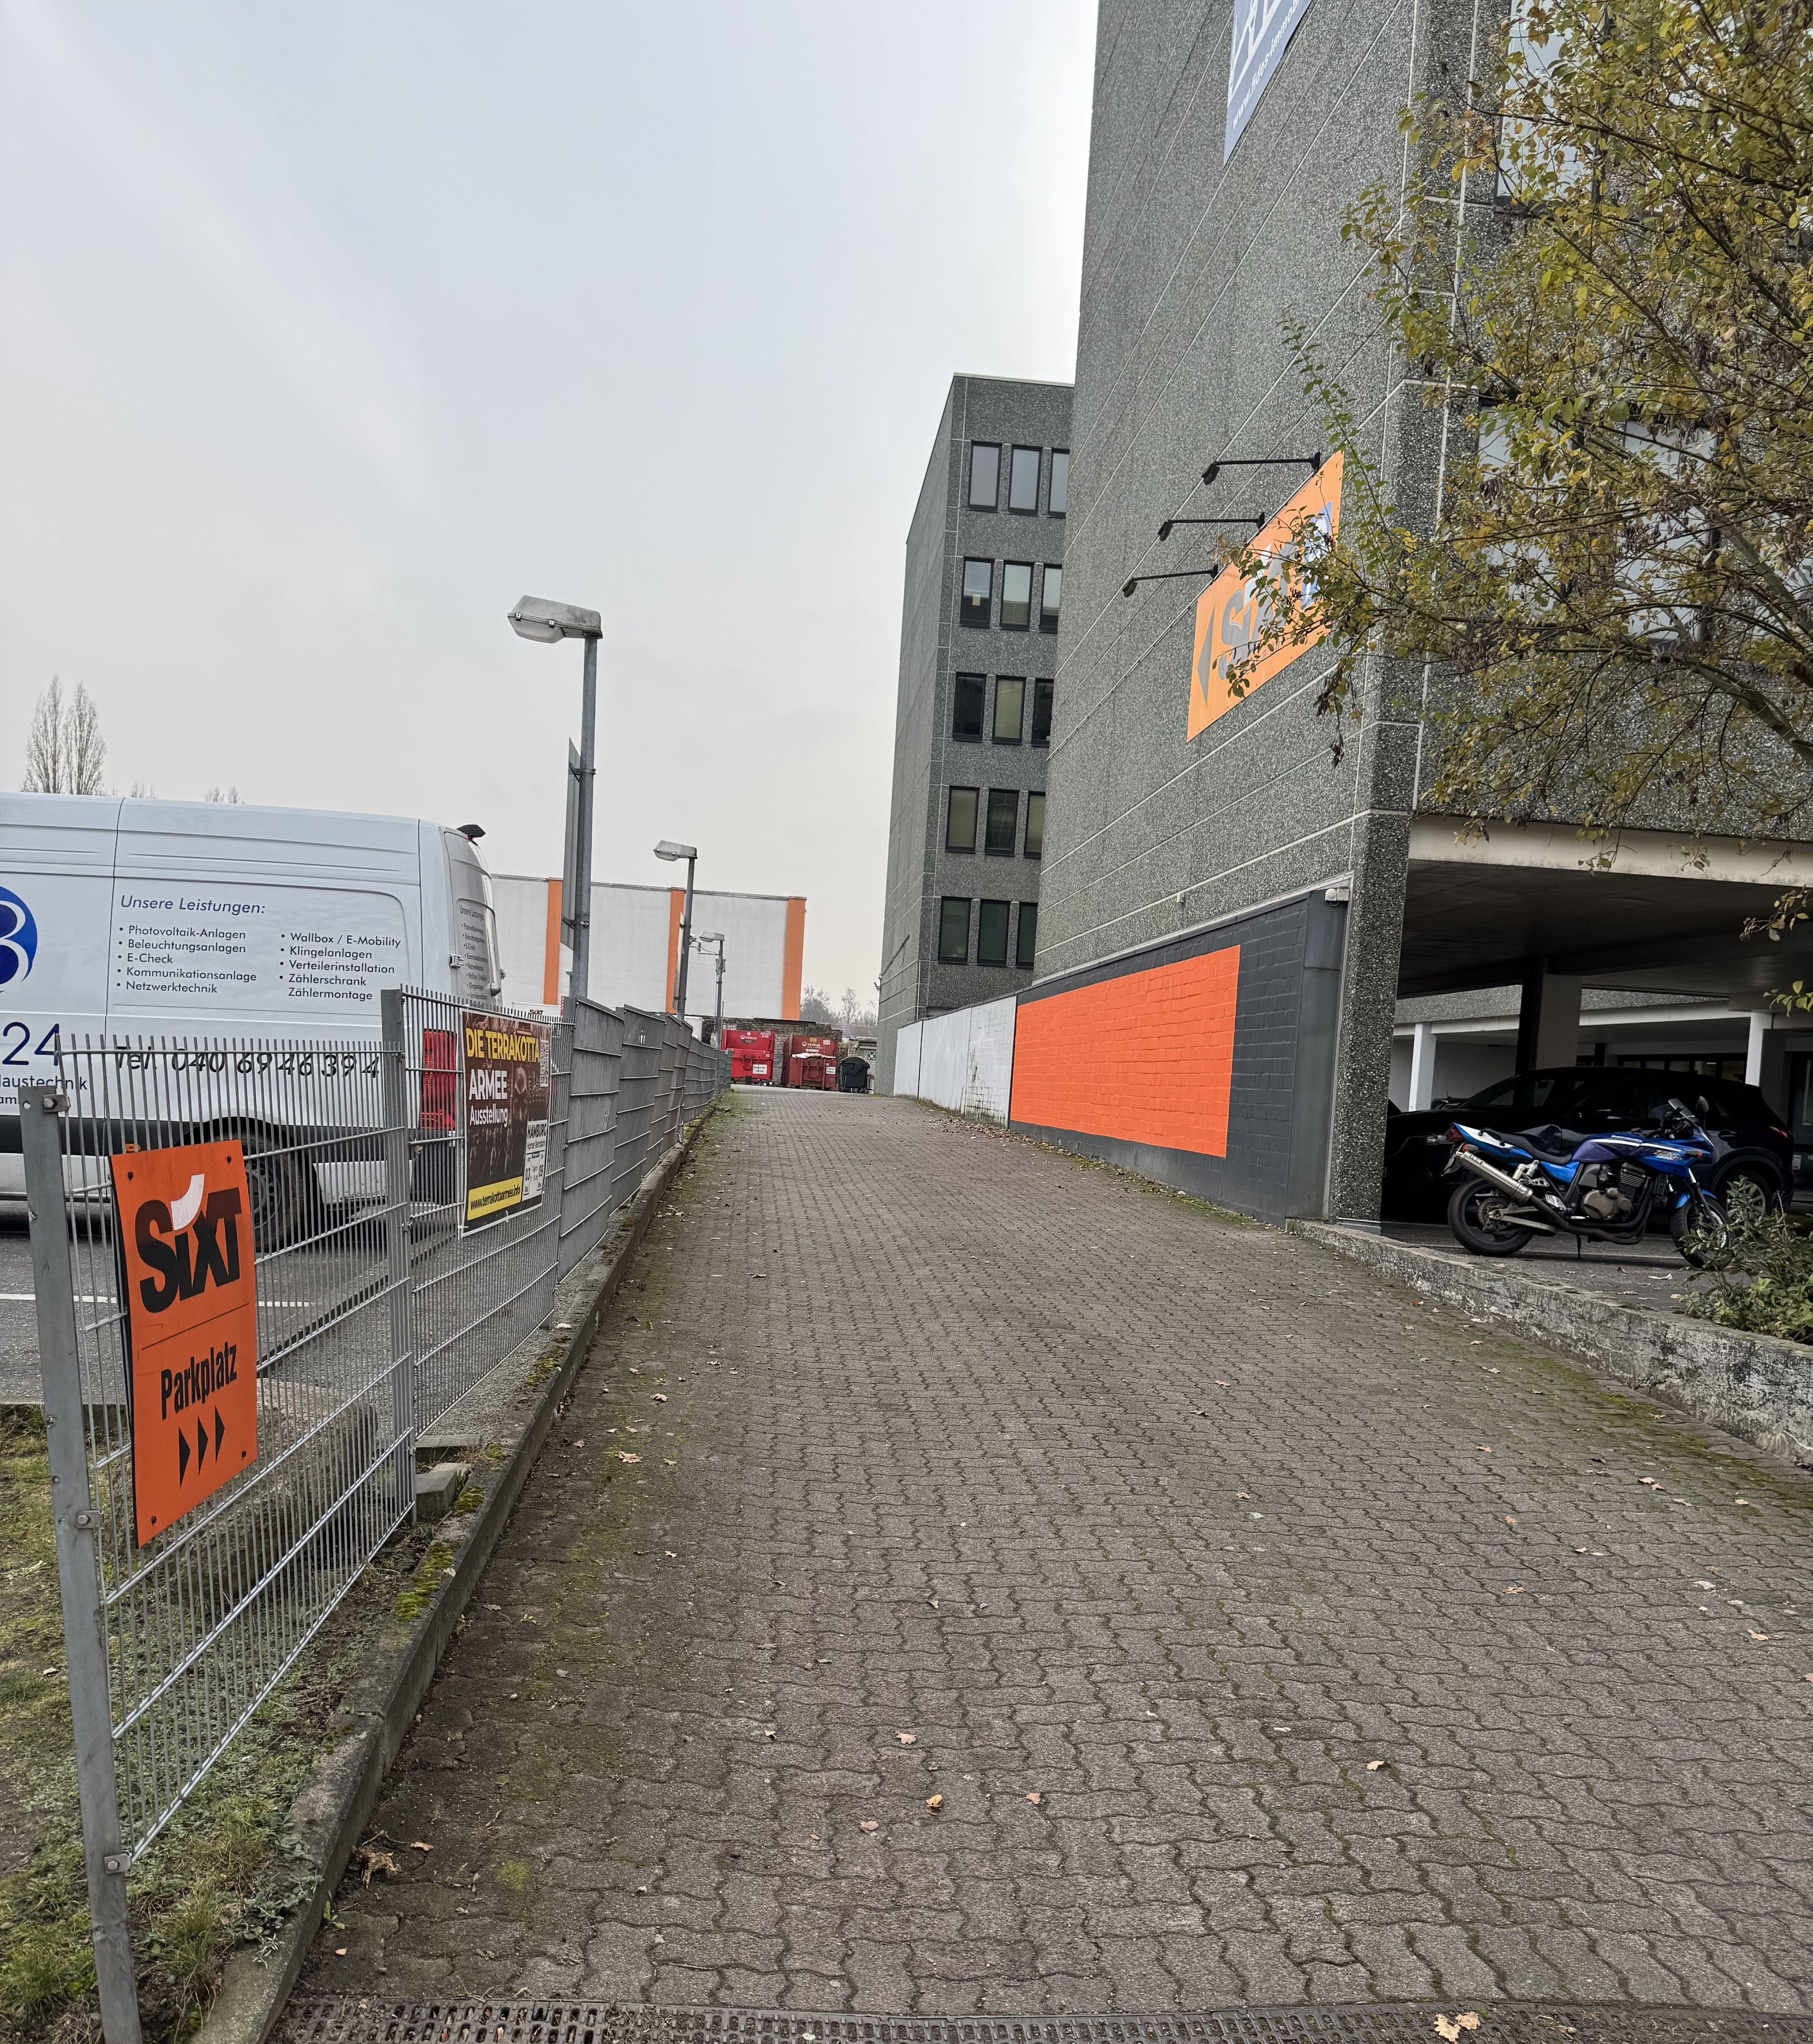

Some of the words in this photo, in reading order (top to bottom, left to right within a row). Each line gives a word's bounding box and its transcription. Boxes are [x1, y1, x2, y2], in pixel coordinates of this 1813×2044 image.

[1233, 0, 1300, 130] www.fides-immob
[121, 895, 173, 910] Unsere
[179, 898, 266, 916] Leistungen:
[129, 925, 246, 940] Photovoltaik-Anlagen
[290, 932, 334, 943] Wallbox
[337, 935, 343, 944] /
[347, 935, 401, 949] E-Mobility
[128, 939, 246, 954] Beleuchtungsanlagen
[290, 946, 372, 960] Klingelanlagen
[127, 953, 173, 963] E-Check
[127, 967, 257, 982] Kommunikationsanlage
[289, 960, 394, 973] Verteilerinstallation
[127, 981, 217, 993] Netzwerktechnik
[289, 974, 366, 986] Zählerschrank
[288, 988, 372, 1001] Zählermontage
[466, 1028, 485, 1058] DIE
[485, 1031, 540, 1063] TERRAKOTTA
[172, 1048, 225, 1073] 040
[0, 1075, 88, 1090] austechnk
[469, 1069, 508, 1100] ARMEE
[469, 1103, 508, 1128] Ausstellung
[527, 1123, 546, 1139] HAMBURG
[470, 1184, 520, 1211] www.terrakottaarmee.info
[135, 1173, 242, 1313] SIXT
[160, 1342, 237, 1421] Parkplatz
